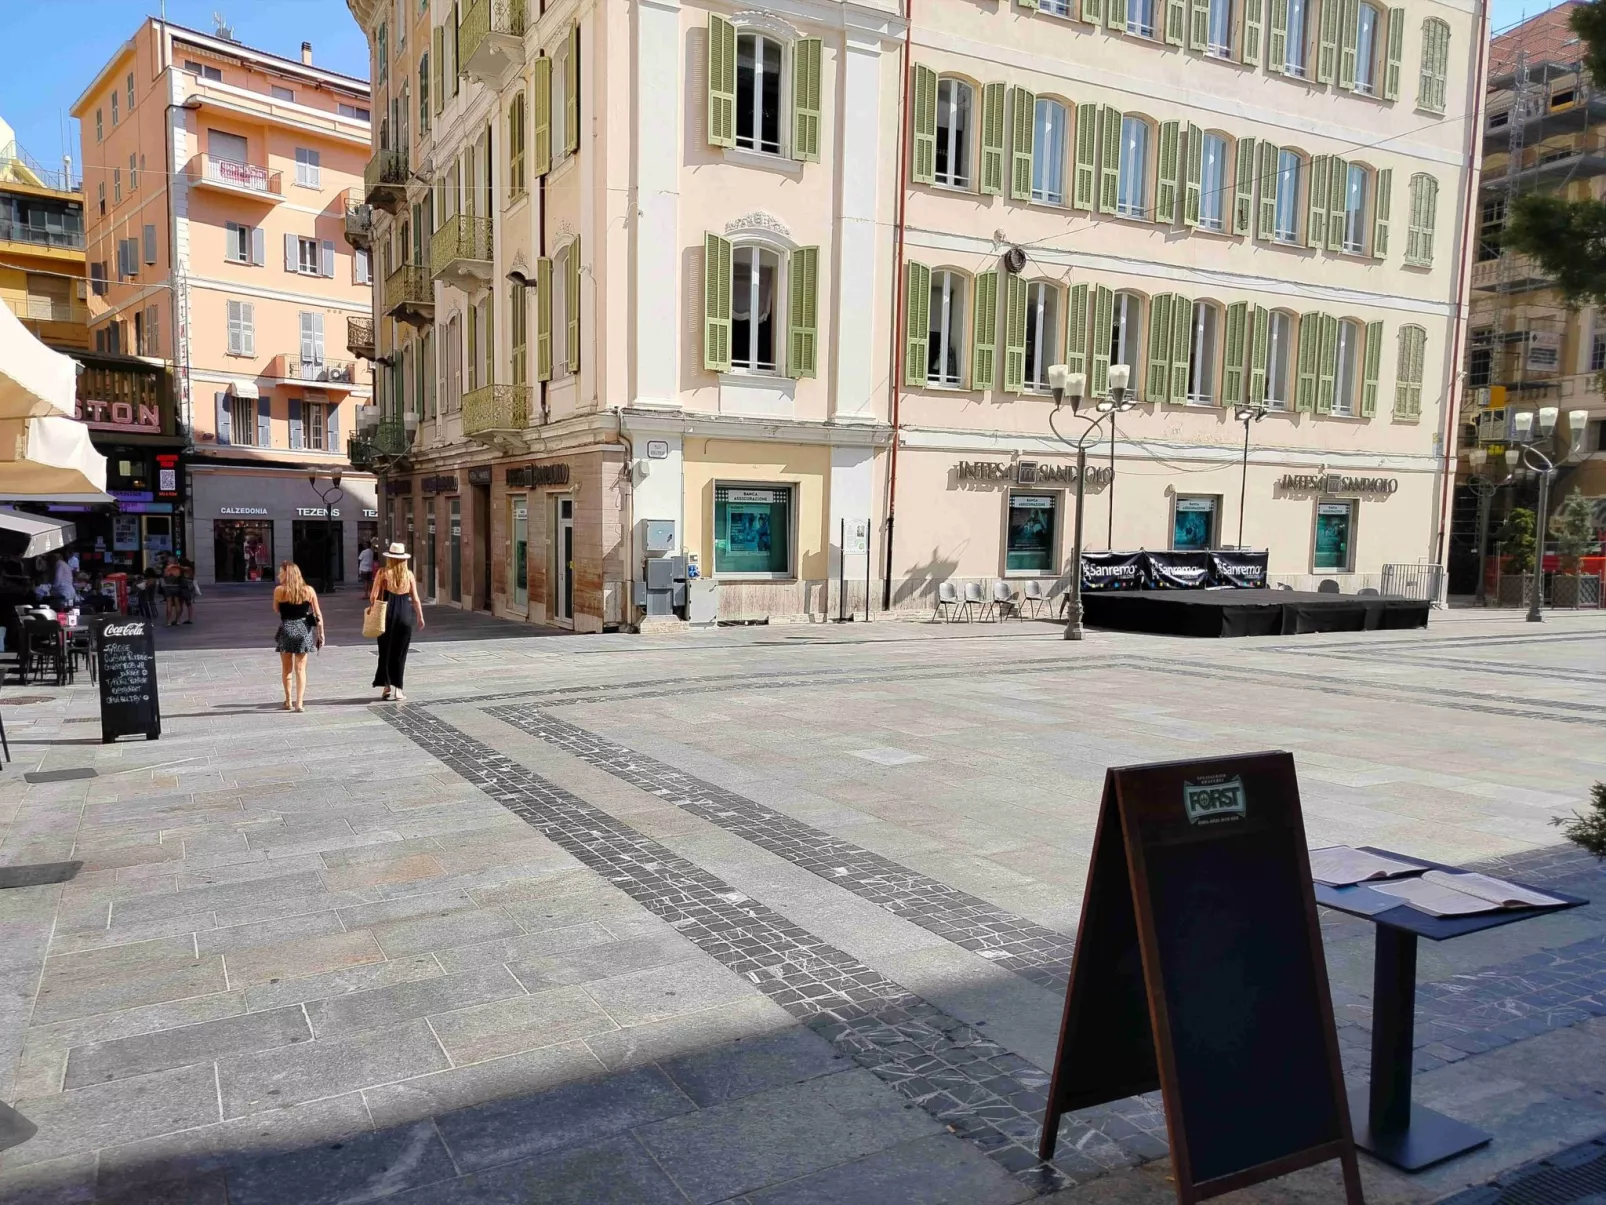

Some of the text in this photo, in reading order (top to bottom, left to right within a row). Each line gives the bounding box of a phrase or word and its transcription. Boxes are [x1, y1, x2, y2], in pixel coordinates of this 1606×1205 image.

[958, 461, 1115, 485] INTESA SANPOLO
[1282, 474, 1398, 493] INTESA SANPAOLO
[220, 507, 268, 515] CALZEDONIA
[1090, 563, 1135, 576] Sanremo
[1158, 563, 1197, 576] Sanremo
[1222, 563, 1261, 575] Sanremo
[1189, 787, 1240, 811] FORST
